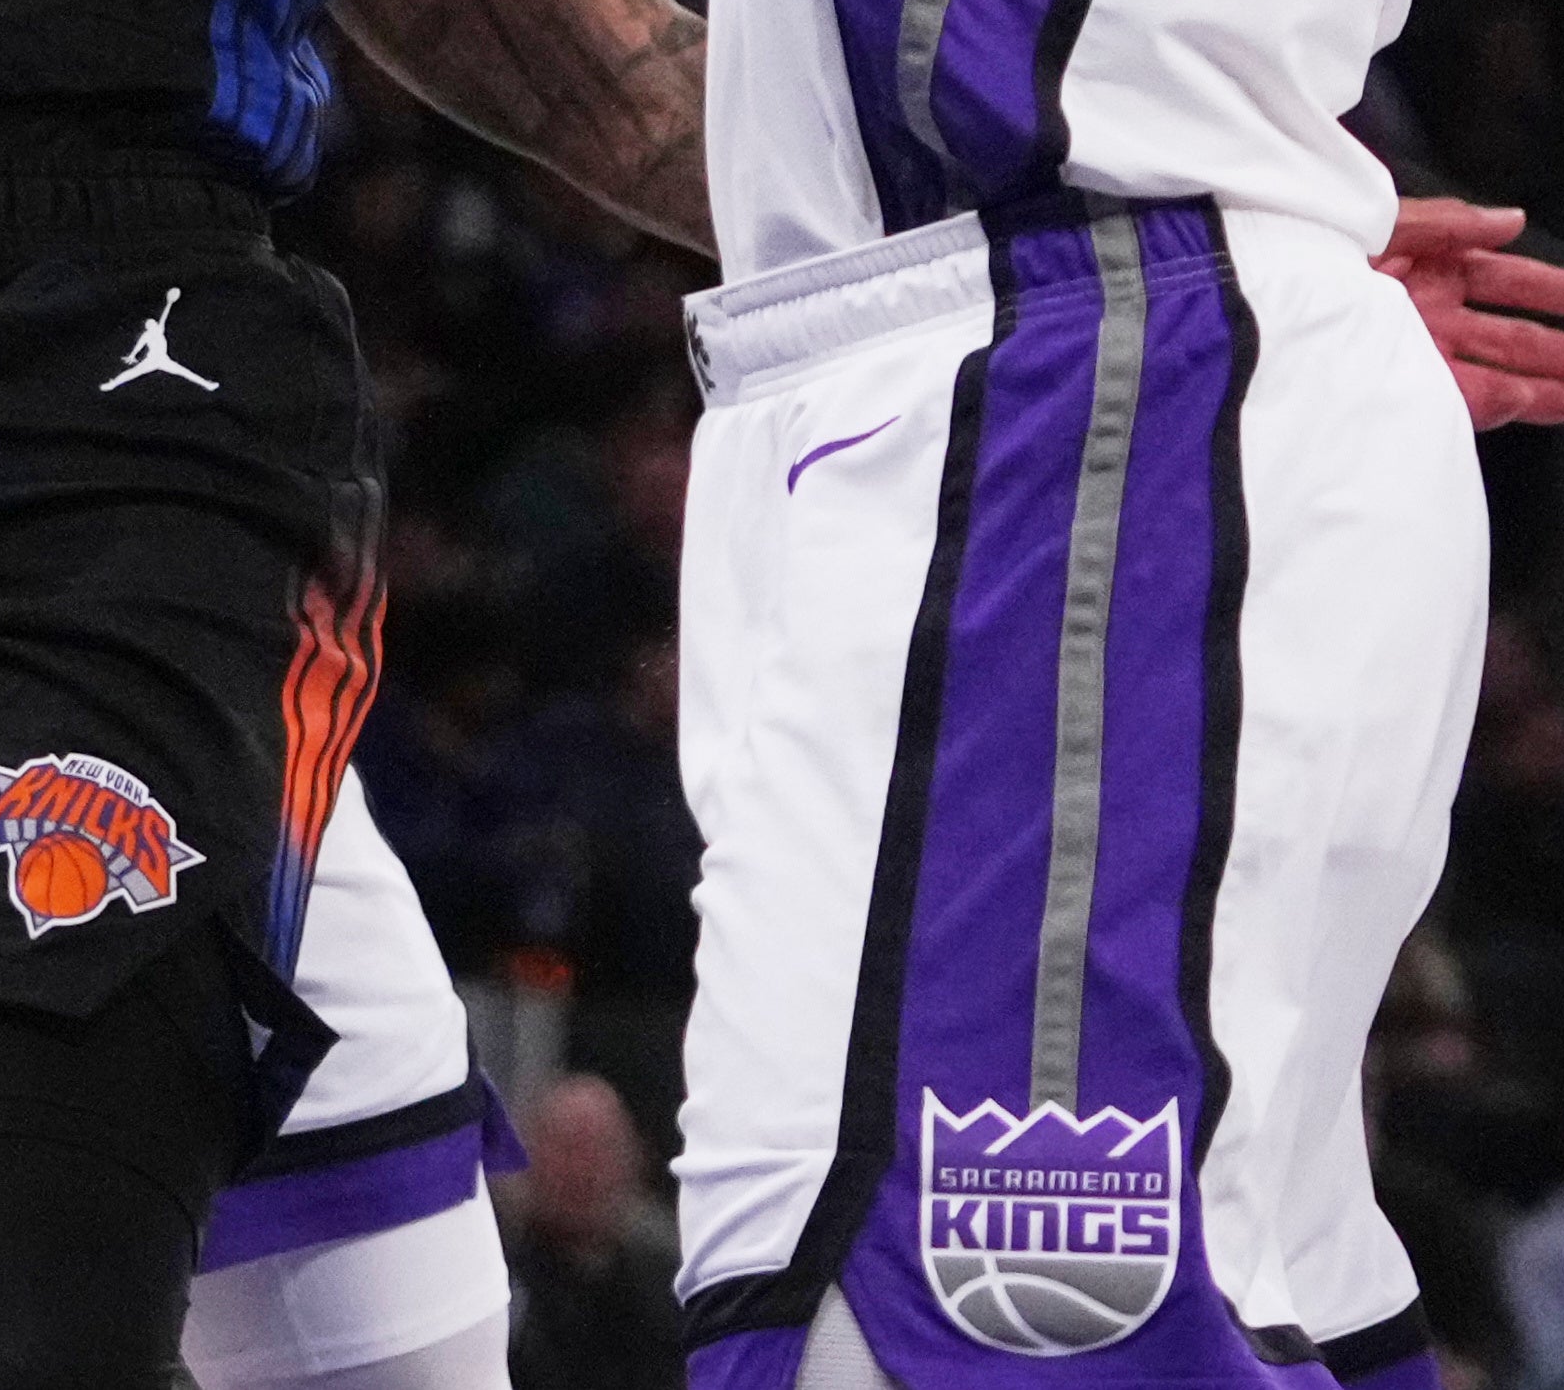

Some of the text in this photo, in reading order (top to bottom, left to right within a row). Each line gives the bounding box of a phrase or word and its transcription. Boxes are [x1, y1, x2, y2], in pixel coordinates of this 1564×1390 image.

[65, 759, 144, 804] NEW YORK
[938, 1166, 1163, 1193] SACRAMENTO
[930, 1198, 1170, 1256] KINGS
